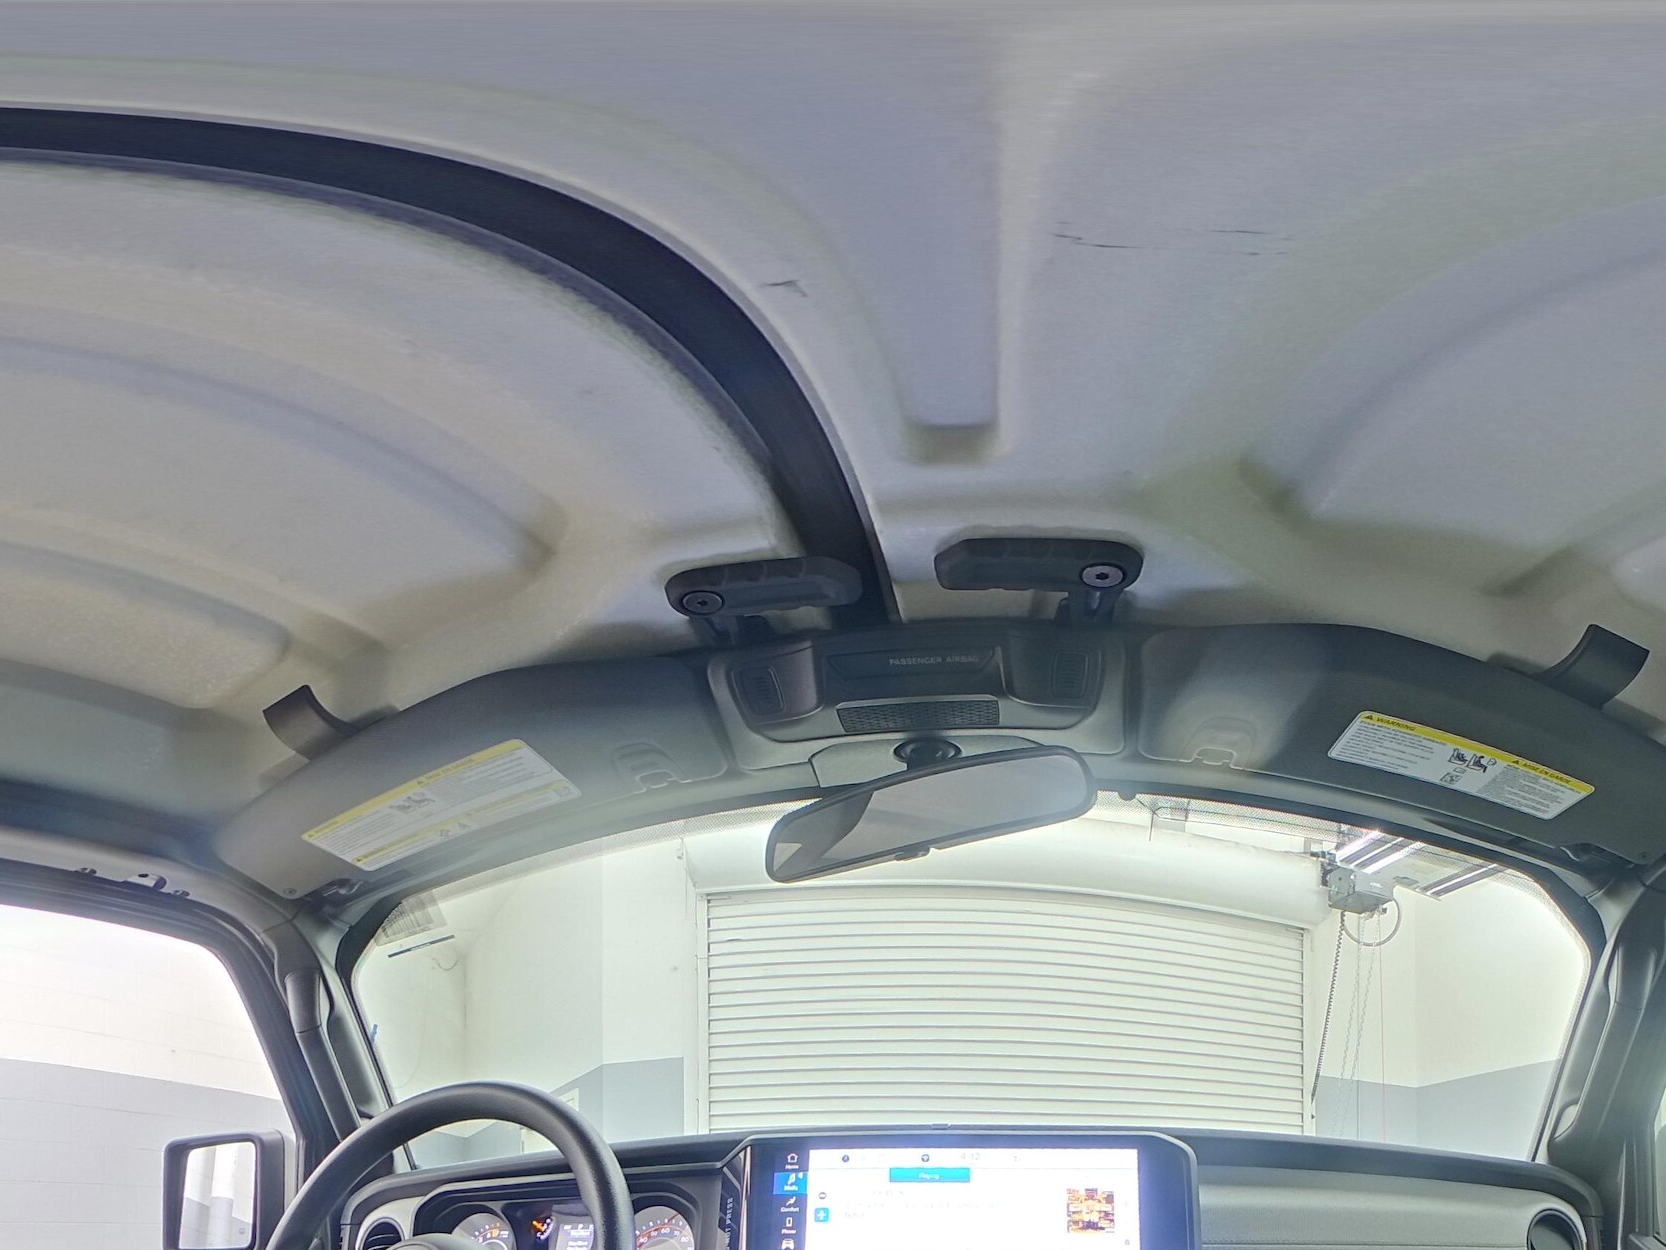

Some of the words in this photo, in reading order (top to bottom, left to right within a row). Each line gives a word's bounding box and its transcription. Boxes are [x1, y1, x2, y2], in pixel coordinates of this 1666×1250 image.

[889, 656, 942, 666] PASSENGER
[946, 655, 980, 664] AIRBAG
[1376, 717, 1417, 732] WARNING
[726, 1197, 734, 1225] PRESS
